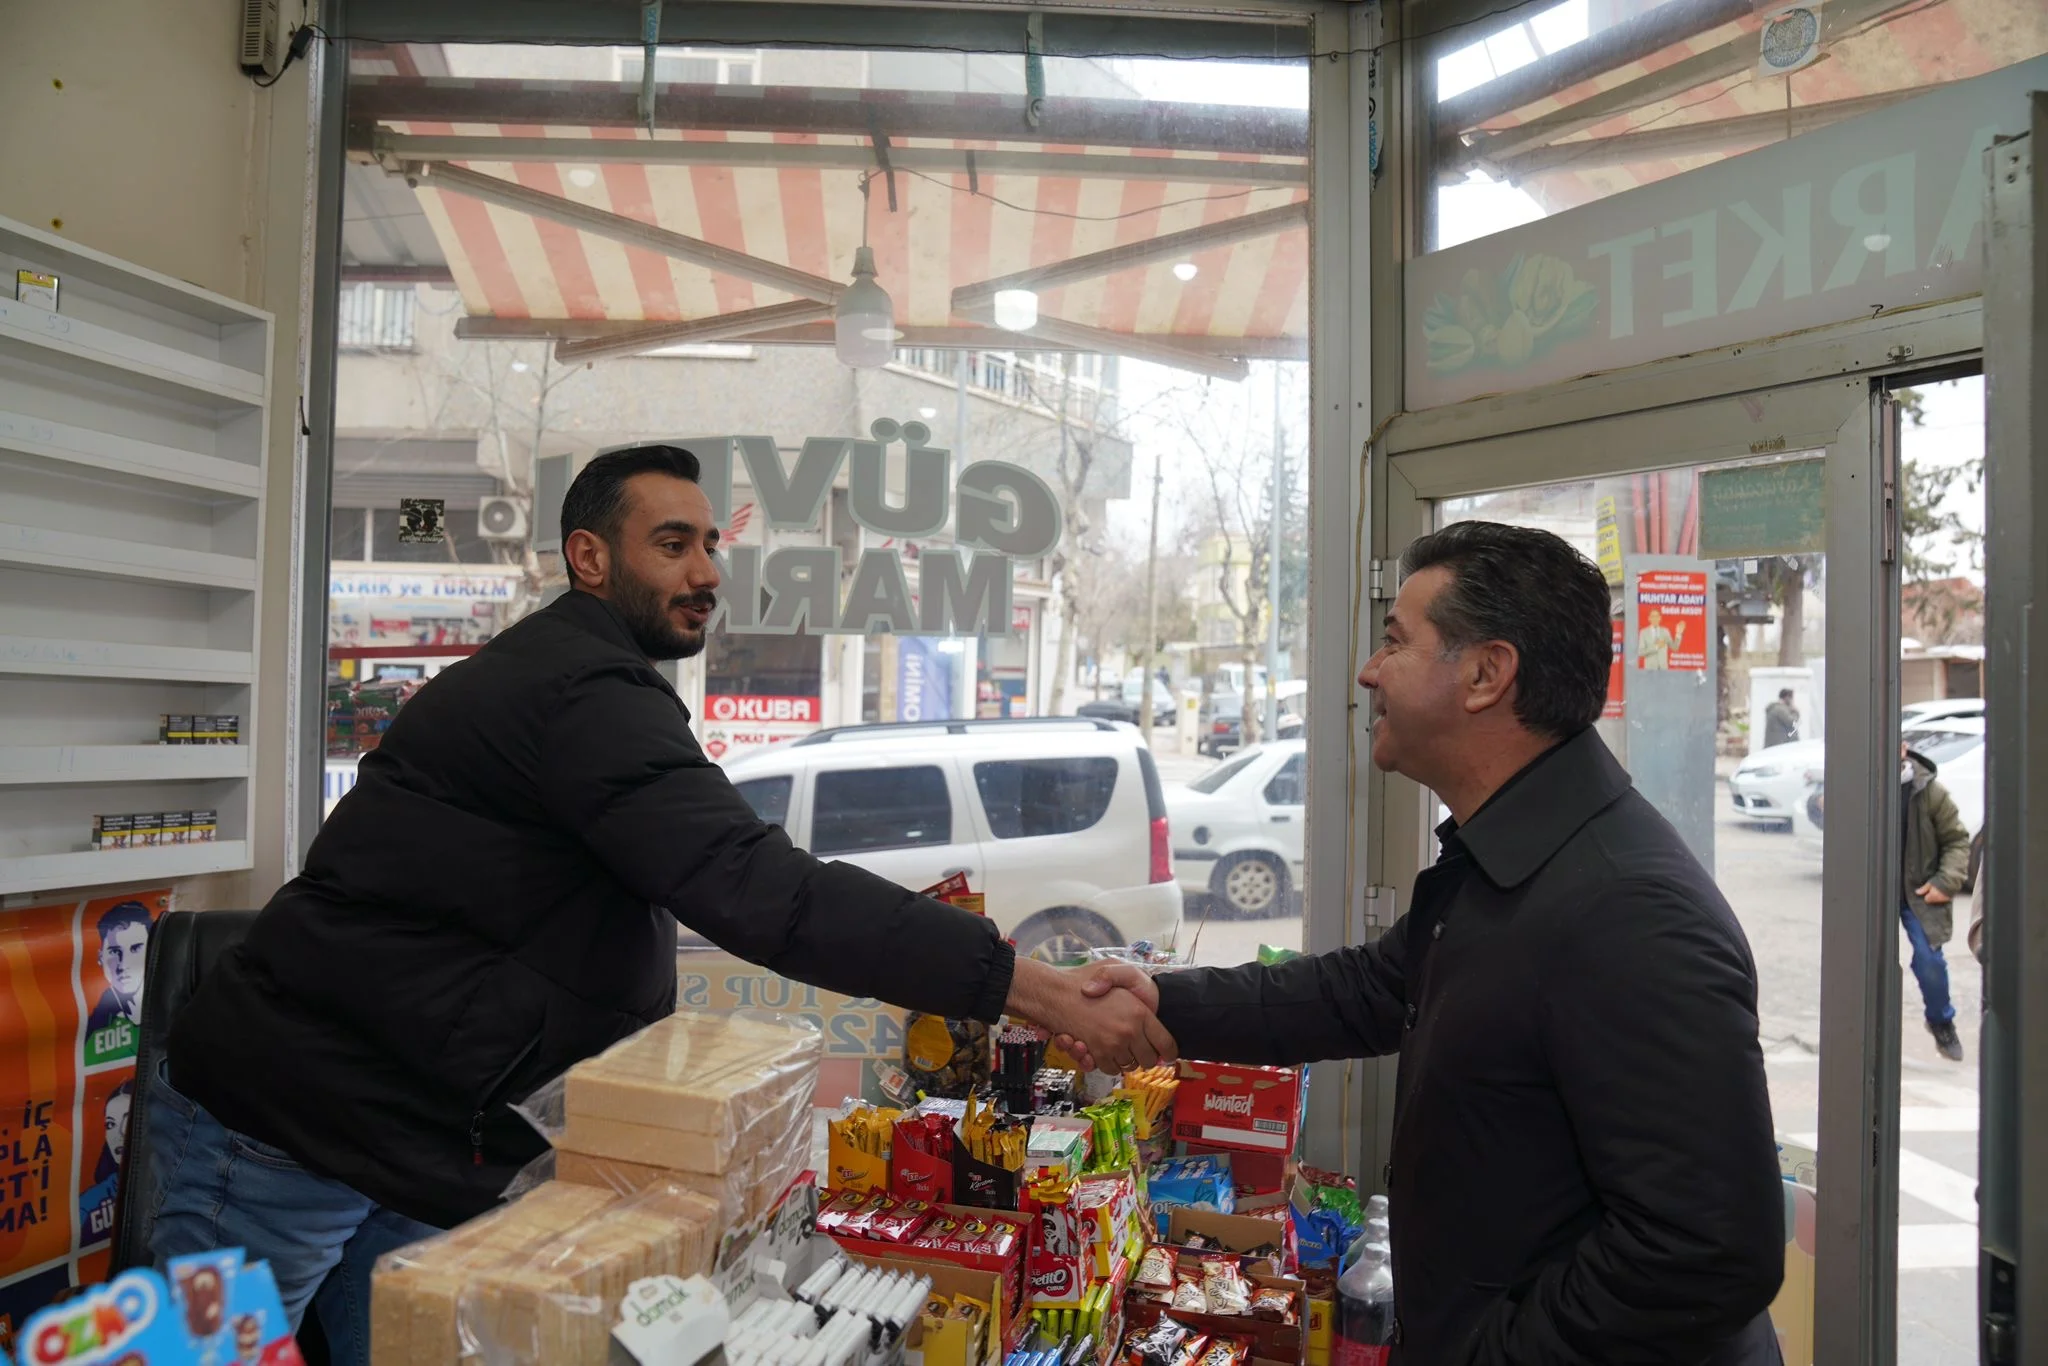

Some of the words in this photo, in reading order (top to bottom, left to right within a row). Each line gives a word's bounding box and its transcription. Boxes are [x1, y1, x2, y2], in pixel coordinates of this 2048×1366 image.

[1640, 593, 1677, 605] MUHTAR
[1678, 594, 1704, 606] ADAYI
[95, 1020, 132, 1054] EDİS
[90, 1199, 115, 1235] GÜ
